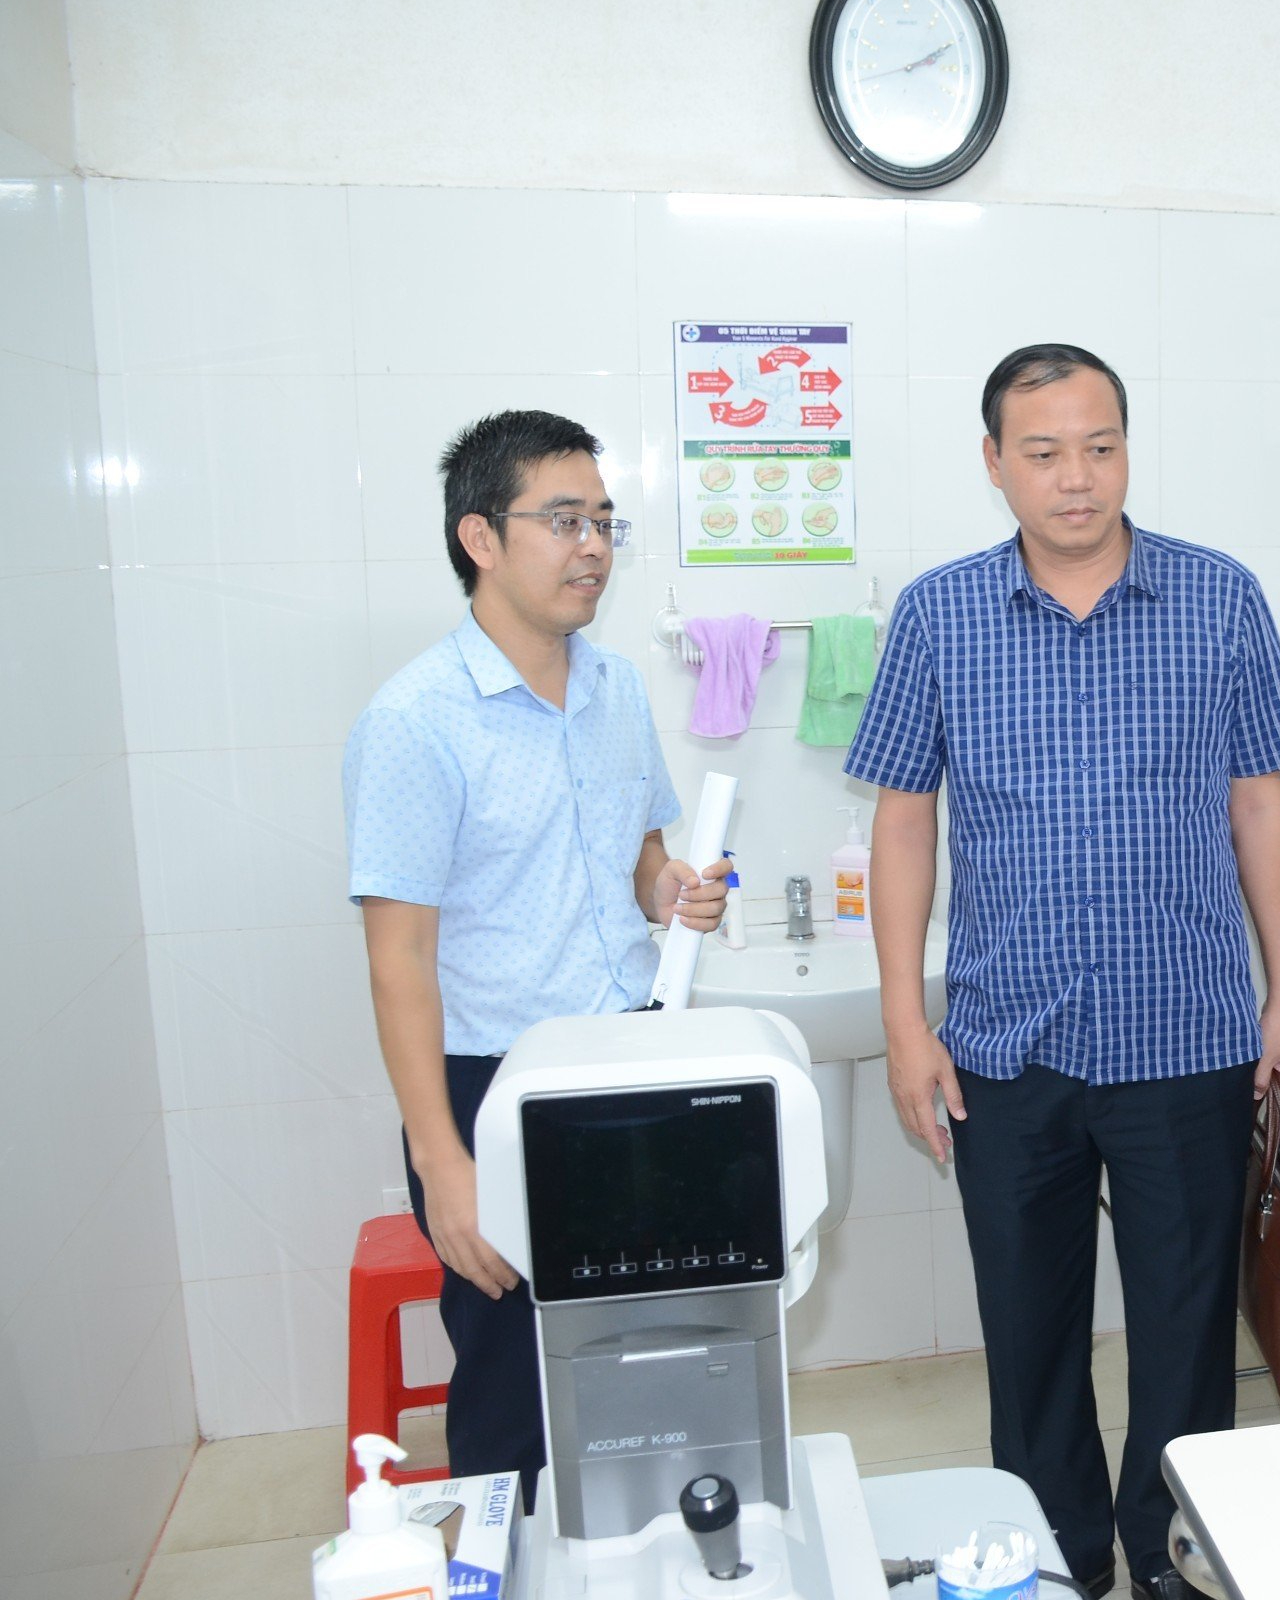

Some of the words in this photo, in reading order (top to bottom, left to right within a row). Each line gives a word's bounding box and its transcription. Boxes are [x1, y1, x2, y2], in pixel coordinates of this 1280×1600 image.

[767, 356, 778, 367] 2
[690, 375, 698, 390] 1
[801, 374, 810, 389] 4
[714, 405, 726, 419] 3
[805, 409, 813, 423] 5
[691, 1095, 742, 1106] SHIN-NIPPON
[586, 1435, 646, 1453] ACCUREF
[651, 1431, 687, 1445] K-900
[492, 1477, 511, 1491] HM
[485, 1494, 508, 1526] GLOVE
